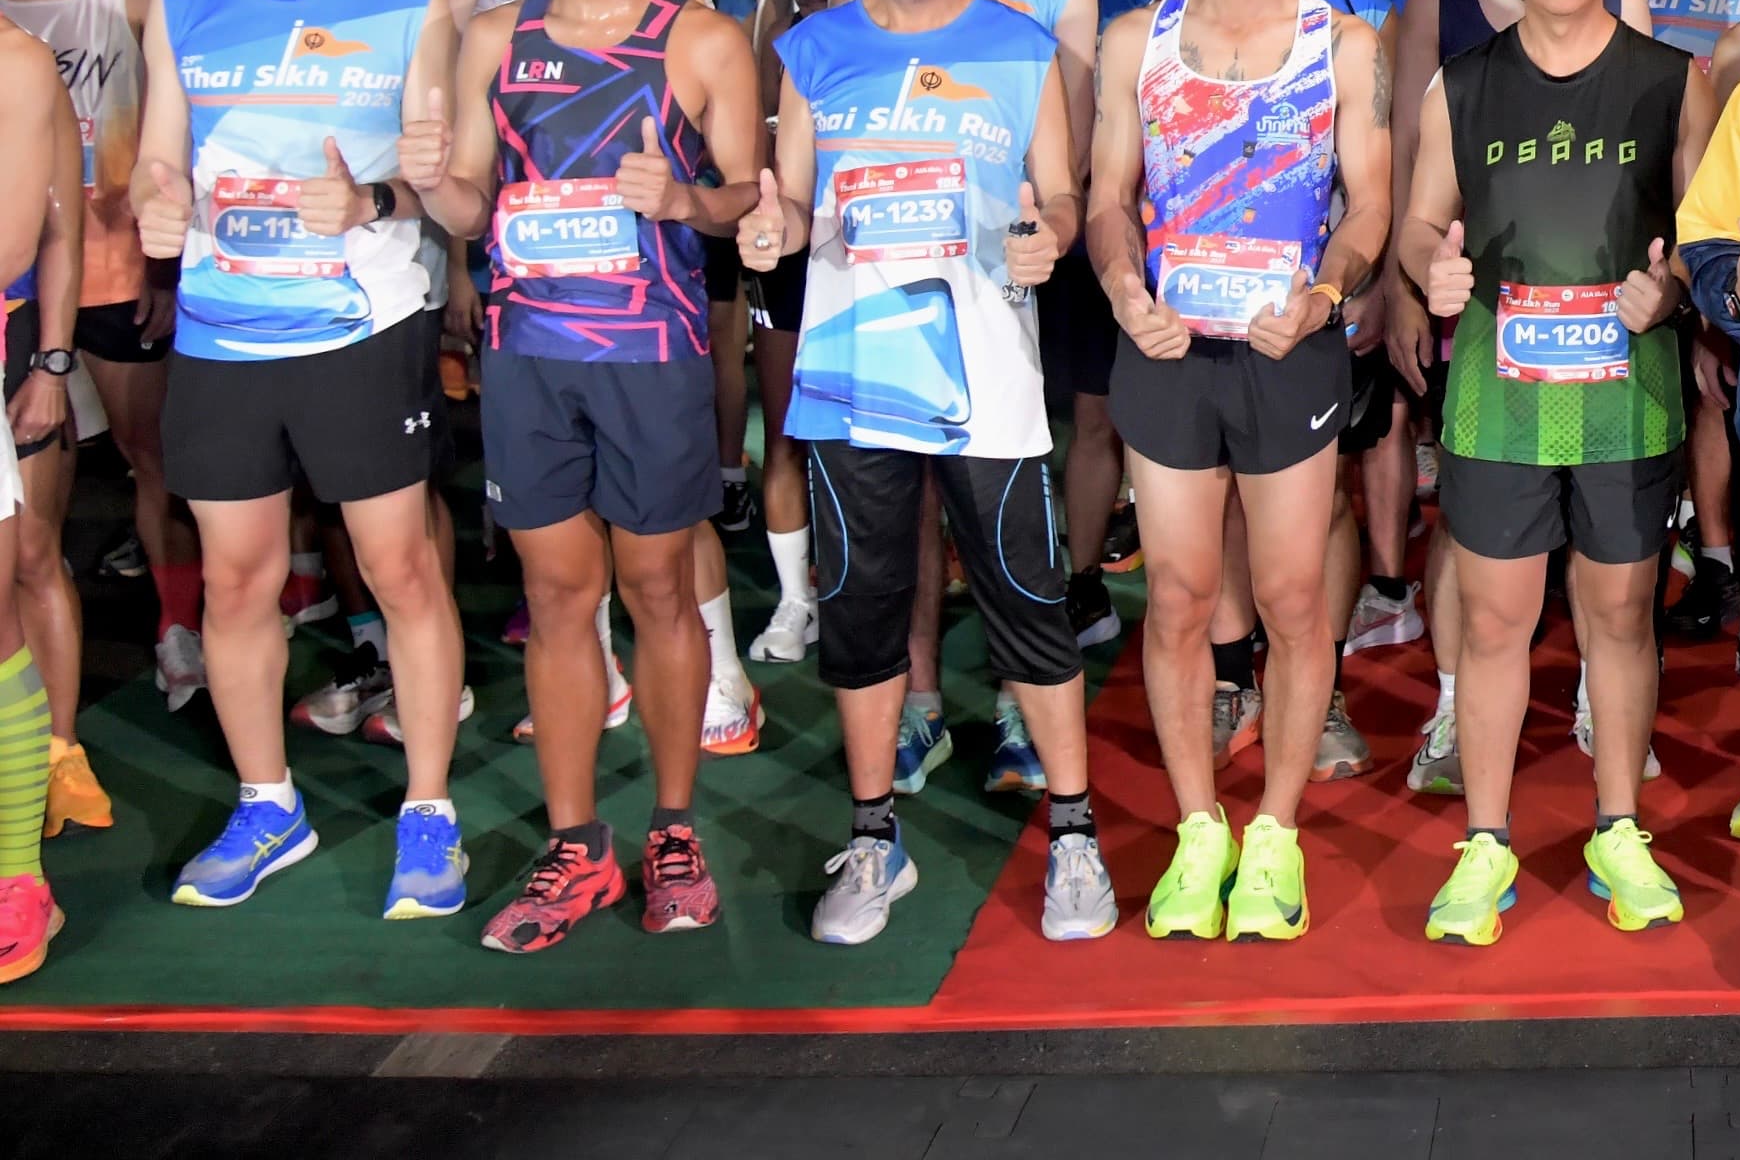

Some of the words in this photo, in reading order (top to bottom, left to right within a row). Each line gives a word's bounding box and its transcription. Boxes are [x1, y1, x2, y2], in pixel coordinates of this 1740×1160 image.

[181, 65, 245, 89] Thai
[253, 64, 329, 88] Sikh
[339, 66, 402, 90] Run
[516, 60, 564, 80] LRN
[866, 106, 946, 132] Sikh
[958, 111, 1012, 147] Run
[960, 139, 1008, 164] 2025
[1487, 138, 1637, 166] DSARG
[851, 198, 955, 228] M-1239
[226, 215, 328, 240] M-113
[516, 215, 619, 242] M-1120
[1515, 321, 1619, 346] M-1206
